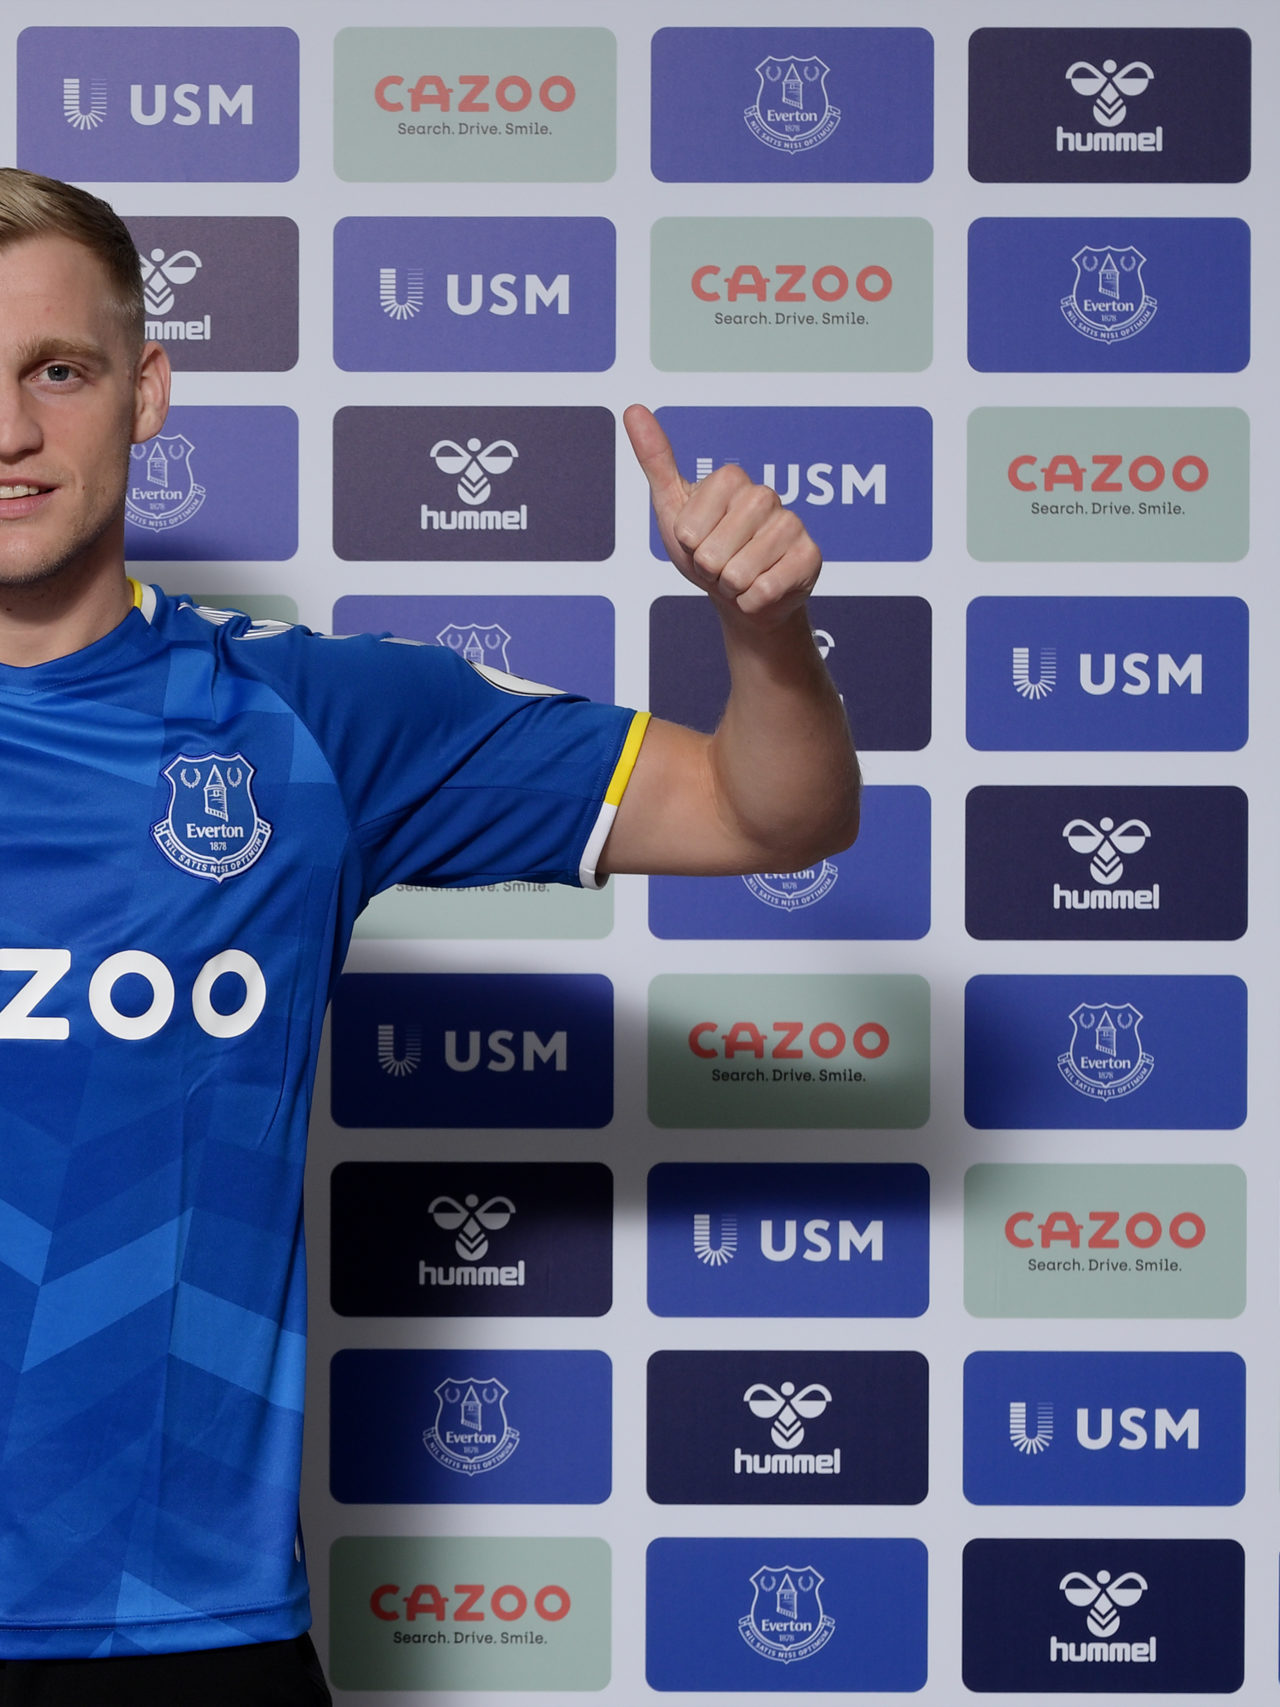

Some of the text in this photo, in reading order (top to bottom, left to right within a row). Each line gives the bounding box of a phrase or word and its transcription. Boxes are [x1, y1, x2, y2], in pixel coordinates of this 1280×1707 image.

[129, 82, 253, 126] USM
[375, 75, 576, 113] CAZOO
[767, 109, 818, 122] Everton
[398, 122, 553, 136] Search. Drive. Smile.
[1056, 126, 1163, 152] hummel
[446, 272, 570, 316] USM
[691, 264, 892, 302] CAZOO
[714, 311, 869, 325] Search. Drive. Smile.
[1083, 299, 1134, 312] Everton
[144, 314, 211, 340] mmel
[762, 463, 886, 507] USM
[1008, 454, 1209, 492] CAZOO
[132, 488, 183, 501] Everton
[420, 504, 527, 530] hummel
[1031, 501, 1186, 515] Search. Drive. Smile.
[1079, 652, 1203, 696] USM
[186, 823, 244, 839] Everton
[163, 837, 263, 873] NIL SATIS NISI OPTIMUM
[209, 841, 227, 852] 1878
[1053, 883, 1160, 909] hummel
[444, 1029, 568, 1073] USM
[689, 1021, 890, 1059] CAZOO
[712, 1068, 867, 1082] Search. Drive. Smile.
[1080, 1056, 1131, 1069] Everton
[760, 1218, 884, 1262] USM
[1005, 1211, 1206, 1249] CAZOO
[418, 1260, 525, 1286] hummel
[1028, 1258, 1183, 1272] Search. Drive. Smile.
[446, 1431, 497, 1444] Everton
[1076, 1407, 1200, 1451] USM
[734, 1448, 841, 1474] hummel
[370, 1584, 571, 1622] CAZOO
[393, 1631, 548, 1645] Search. Drive. Smile.
[761, 1619, 812, 1632] Everton
[1050, 1636, 1157, 1662] hummel
